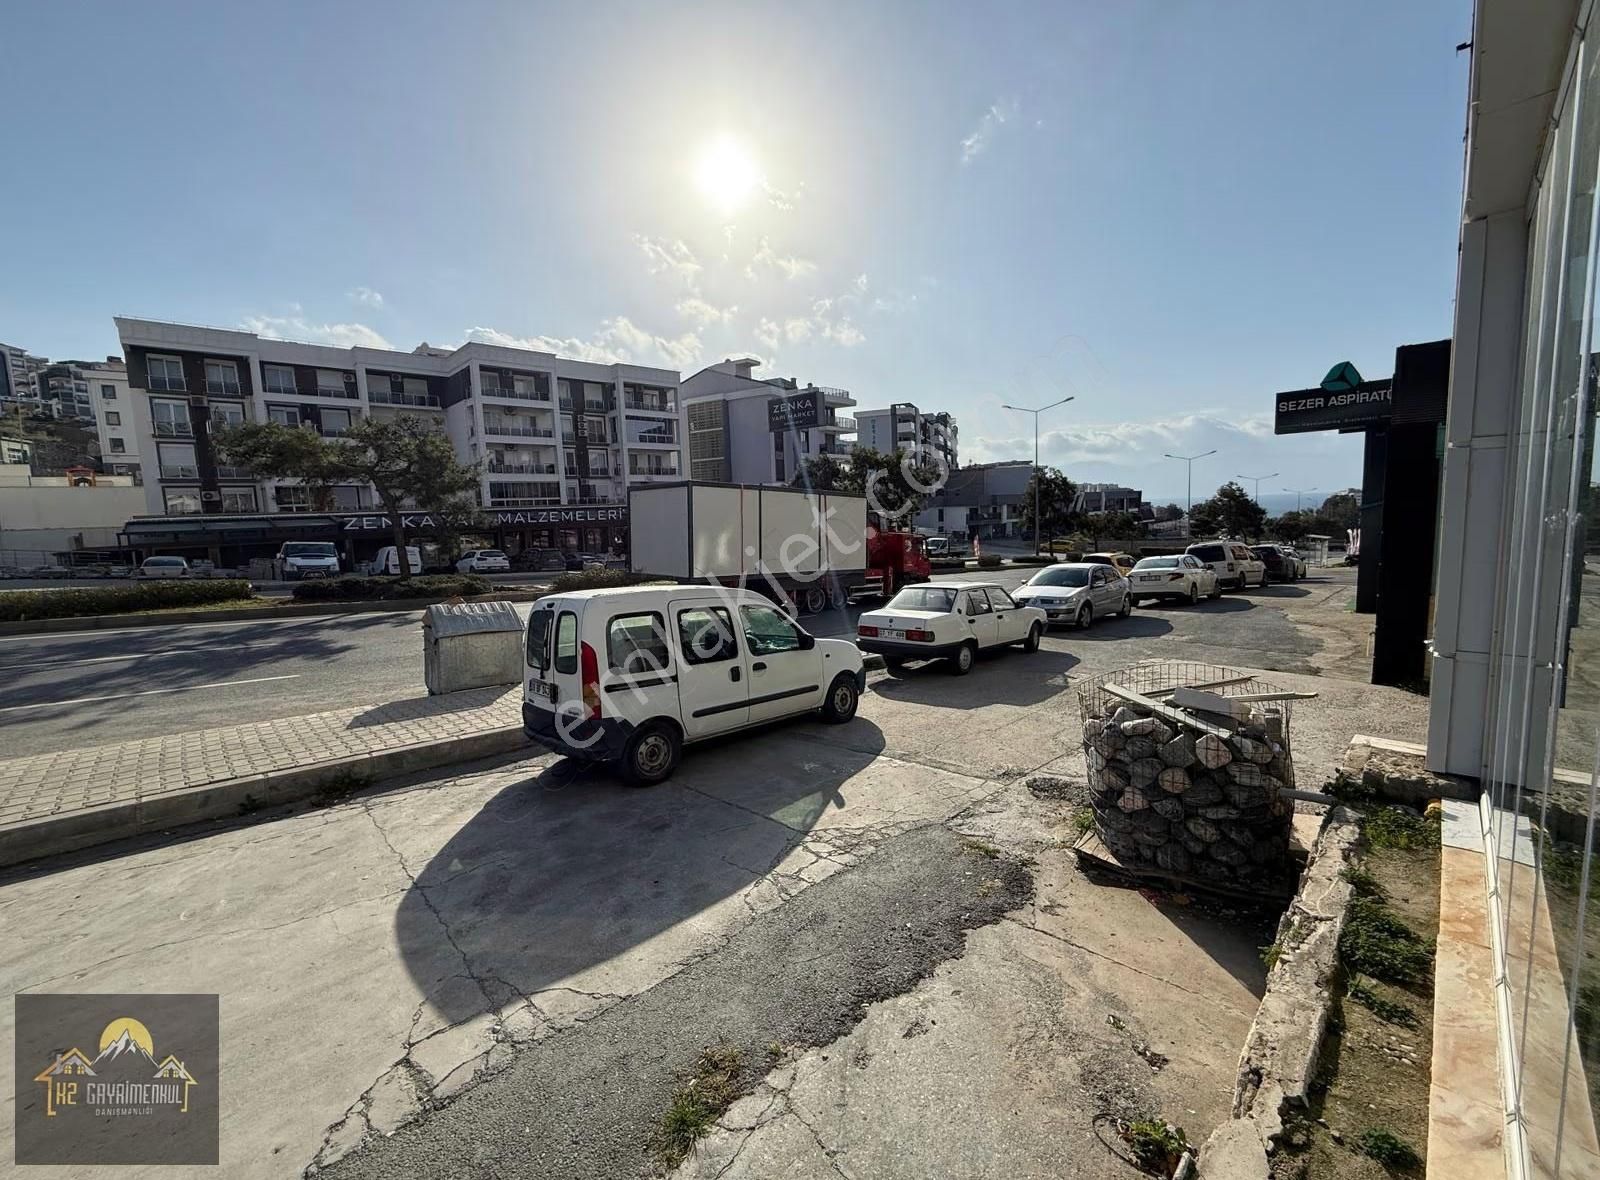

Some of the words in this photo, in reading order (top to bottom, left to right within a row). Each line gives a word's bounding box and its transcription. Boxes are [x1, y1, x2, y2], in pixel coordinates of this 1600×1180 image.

[773, 399, 813, 414] ZENKA
[1279, 397, 1325, 413] SEZER
[498, 508, 623, 524] MALZEMELERİ
